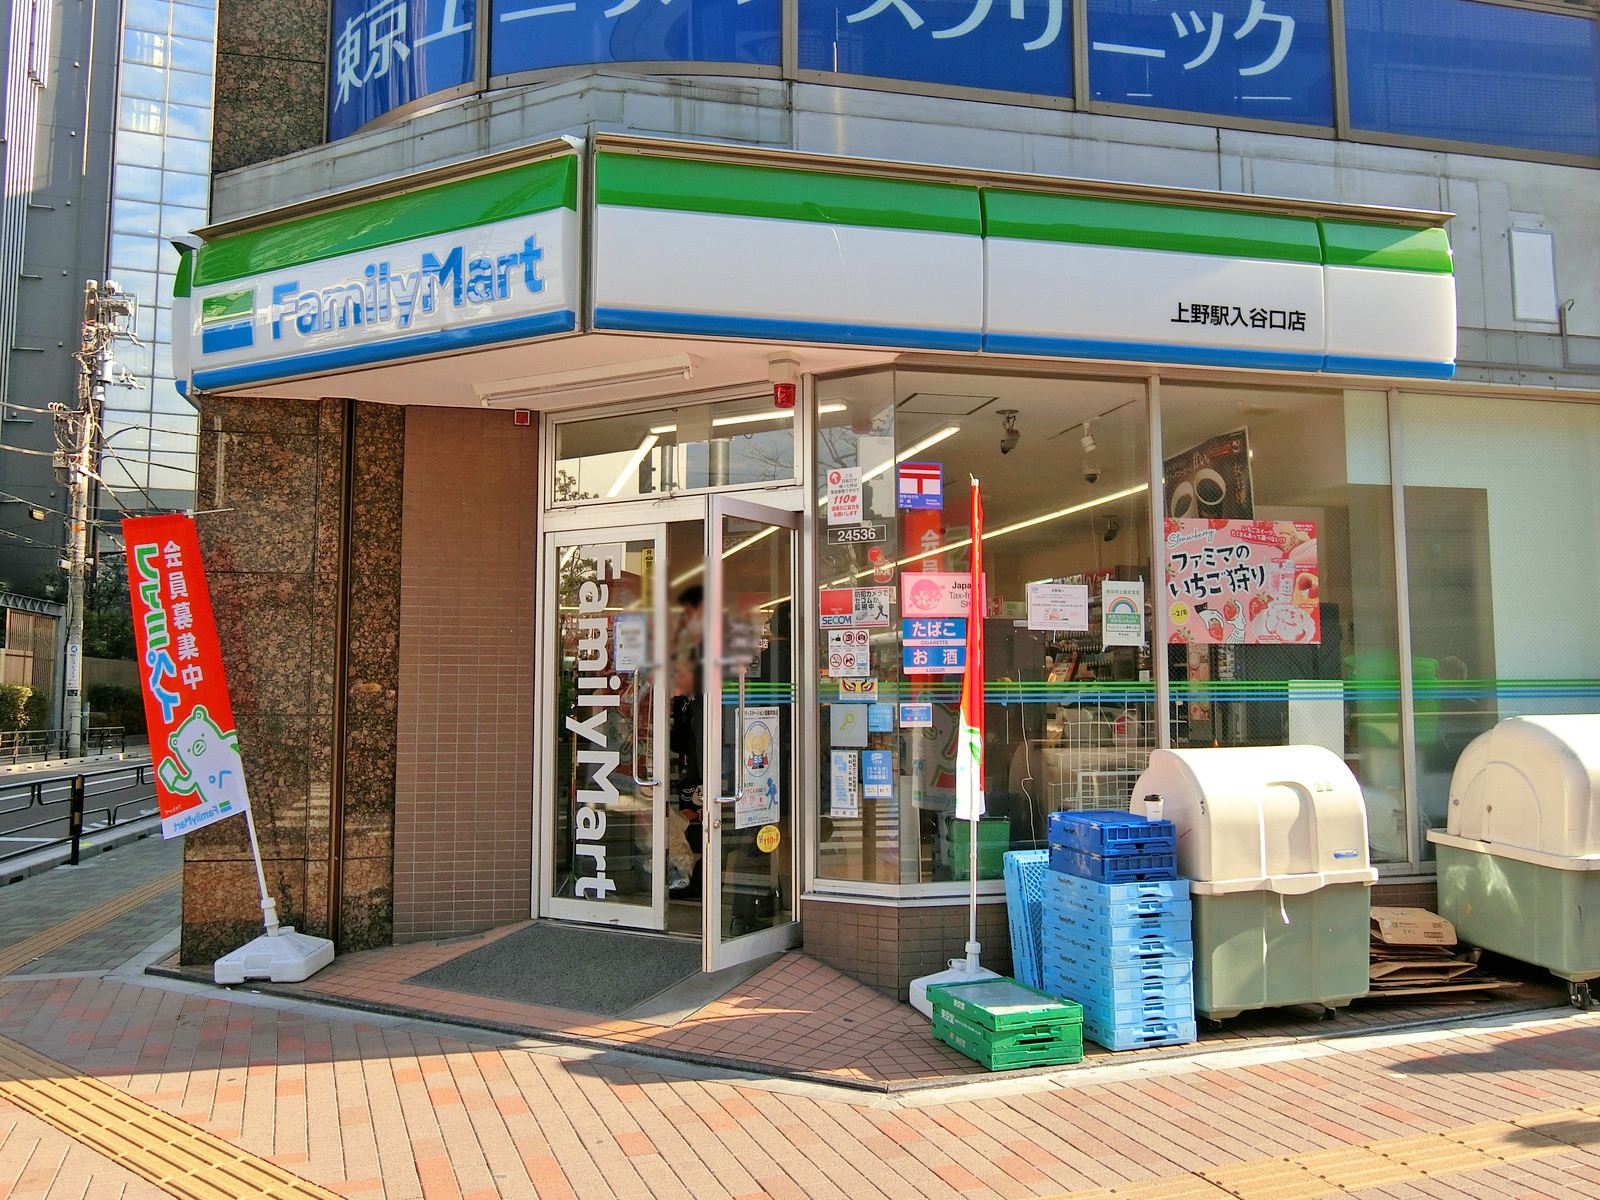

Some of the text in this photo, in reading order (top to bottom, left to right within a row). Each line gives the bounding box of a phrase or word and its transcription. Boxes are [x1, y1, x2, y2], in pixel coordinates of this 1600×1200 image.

[271, 233, 546, 341] FamilyMart
[1170, 302, 1306, 332] 上野駅入谷口店
[837, 529, 876, 542] 24536
[1167, 527, 1217, 548] Strawberry
[1171, 545, 1250, 572] ファミマの
[951, 581, 972, 591] Japa
[1169, 563, 1265, 599] いちご狩り
[854, 590, 888, 598] 防犯カメラで
[948, 591, 972, 600] Tax-fr
[854, 603, 875, 611] 監視中
[822, 615, 852, 625] SECOM
[912, 621, 957, 637] たばこ
[565, 544, 621, 900] FamilyMart
[754, 755, 762, 764] SS
